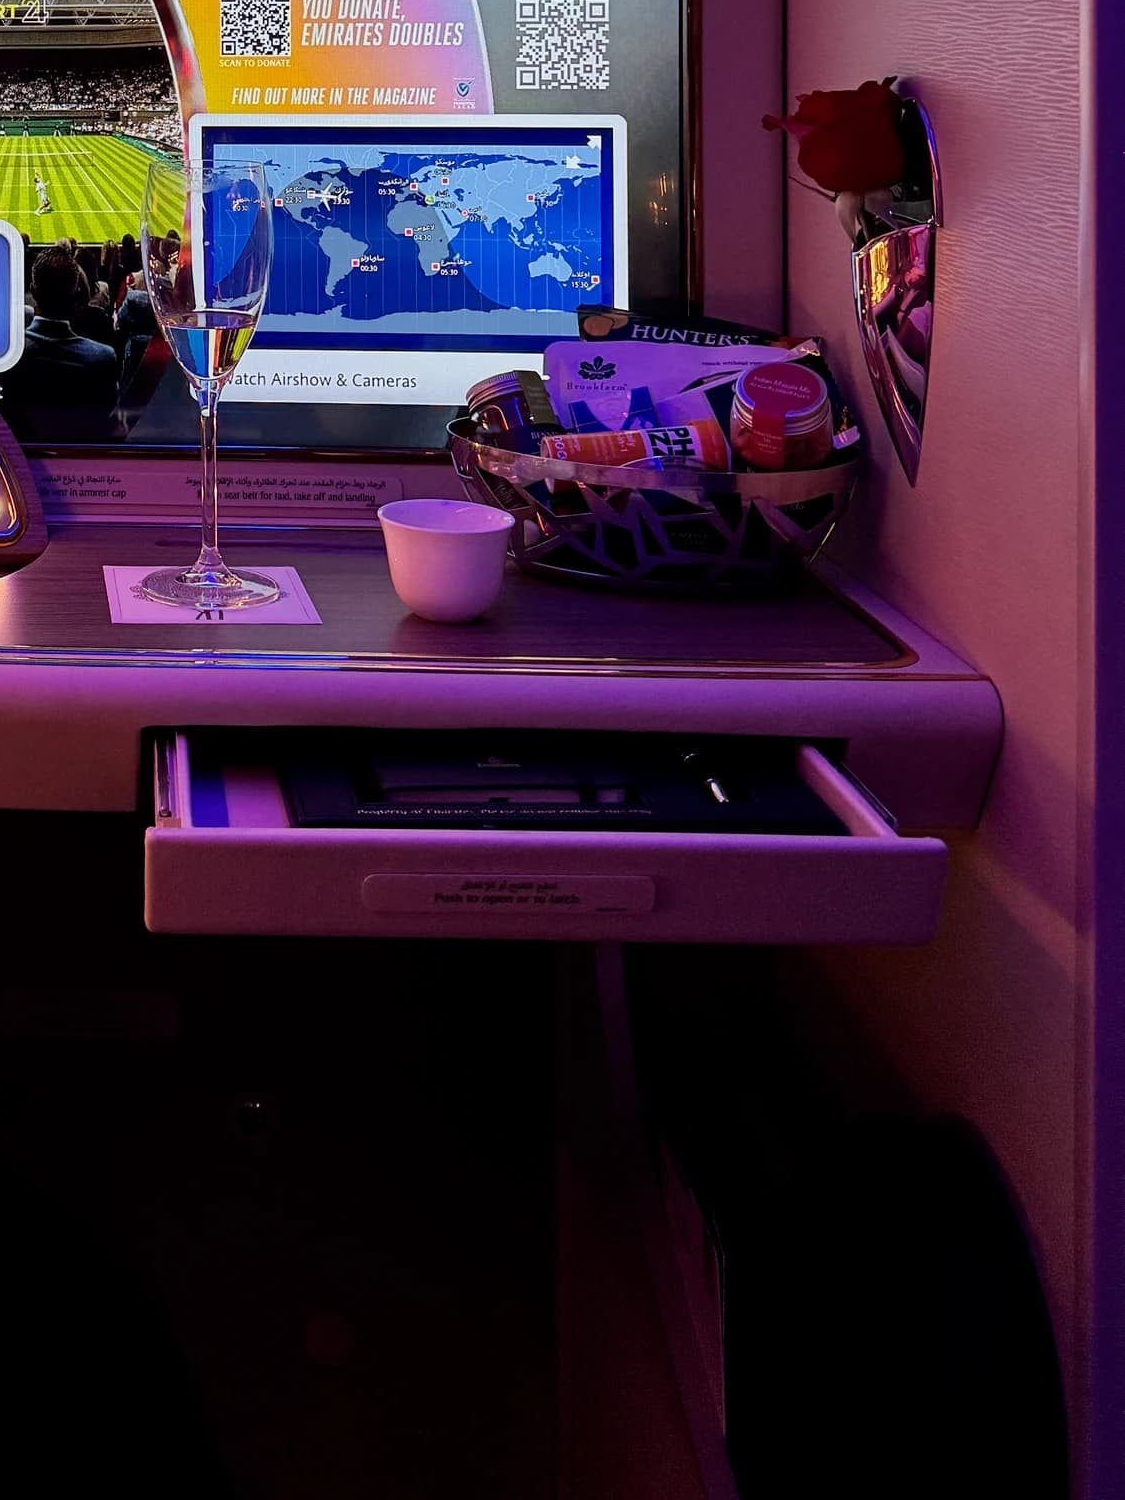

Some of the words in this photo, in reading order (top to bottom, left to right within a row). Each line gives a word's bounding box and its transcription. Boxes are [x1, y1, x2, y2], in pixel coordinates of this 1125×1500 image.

[300, 23, 383, 47] EMIRATES
[388, 21, 465, 47] DOUBLES
[219, 59, 242, 68] SCAN
[244, 59, 255, 68] TO
[257, 59, 292, 68] DONATE
[231, 87, 260, 106] FIND
[264, 87, 289, 105] OUT
[291, 87, 325, 105] MORE
[329, 87, 342, 105] IN
[347, 87, 369, 105] THE
[372, 87, 437, 105] MAGAZINE
[631, 323, 751, 347] HUNTER'S
[229, 372, 266, 386] atch
[271, 372, 332, 386] Airshow
[336, 373, 347, 387] &
[352, 373, 418, 388] Cameras
[111, 489, 127, 500] cap
[224, 491, 240, 500] seat
[242, 490, 258, 500] belt
[260, 490, 272, 500] for
[294, 491, 312, 501] take
[313, 491, 326, 501] off
[328, 492, 343, 501] and
[345, 492, 376, 505] landing
